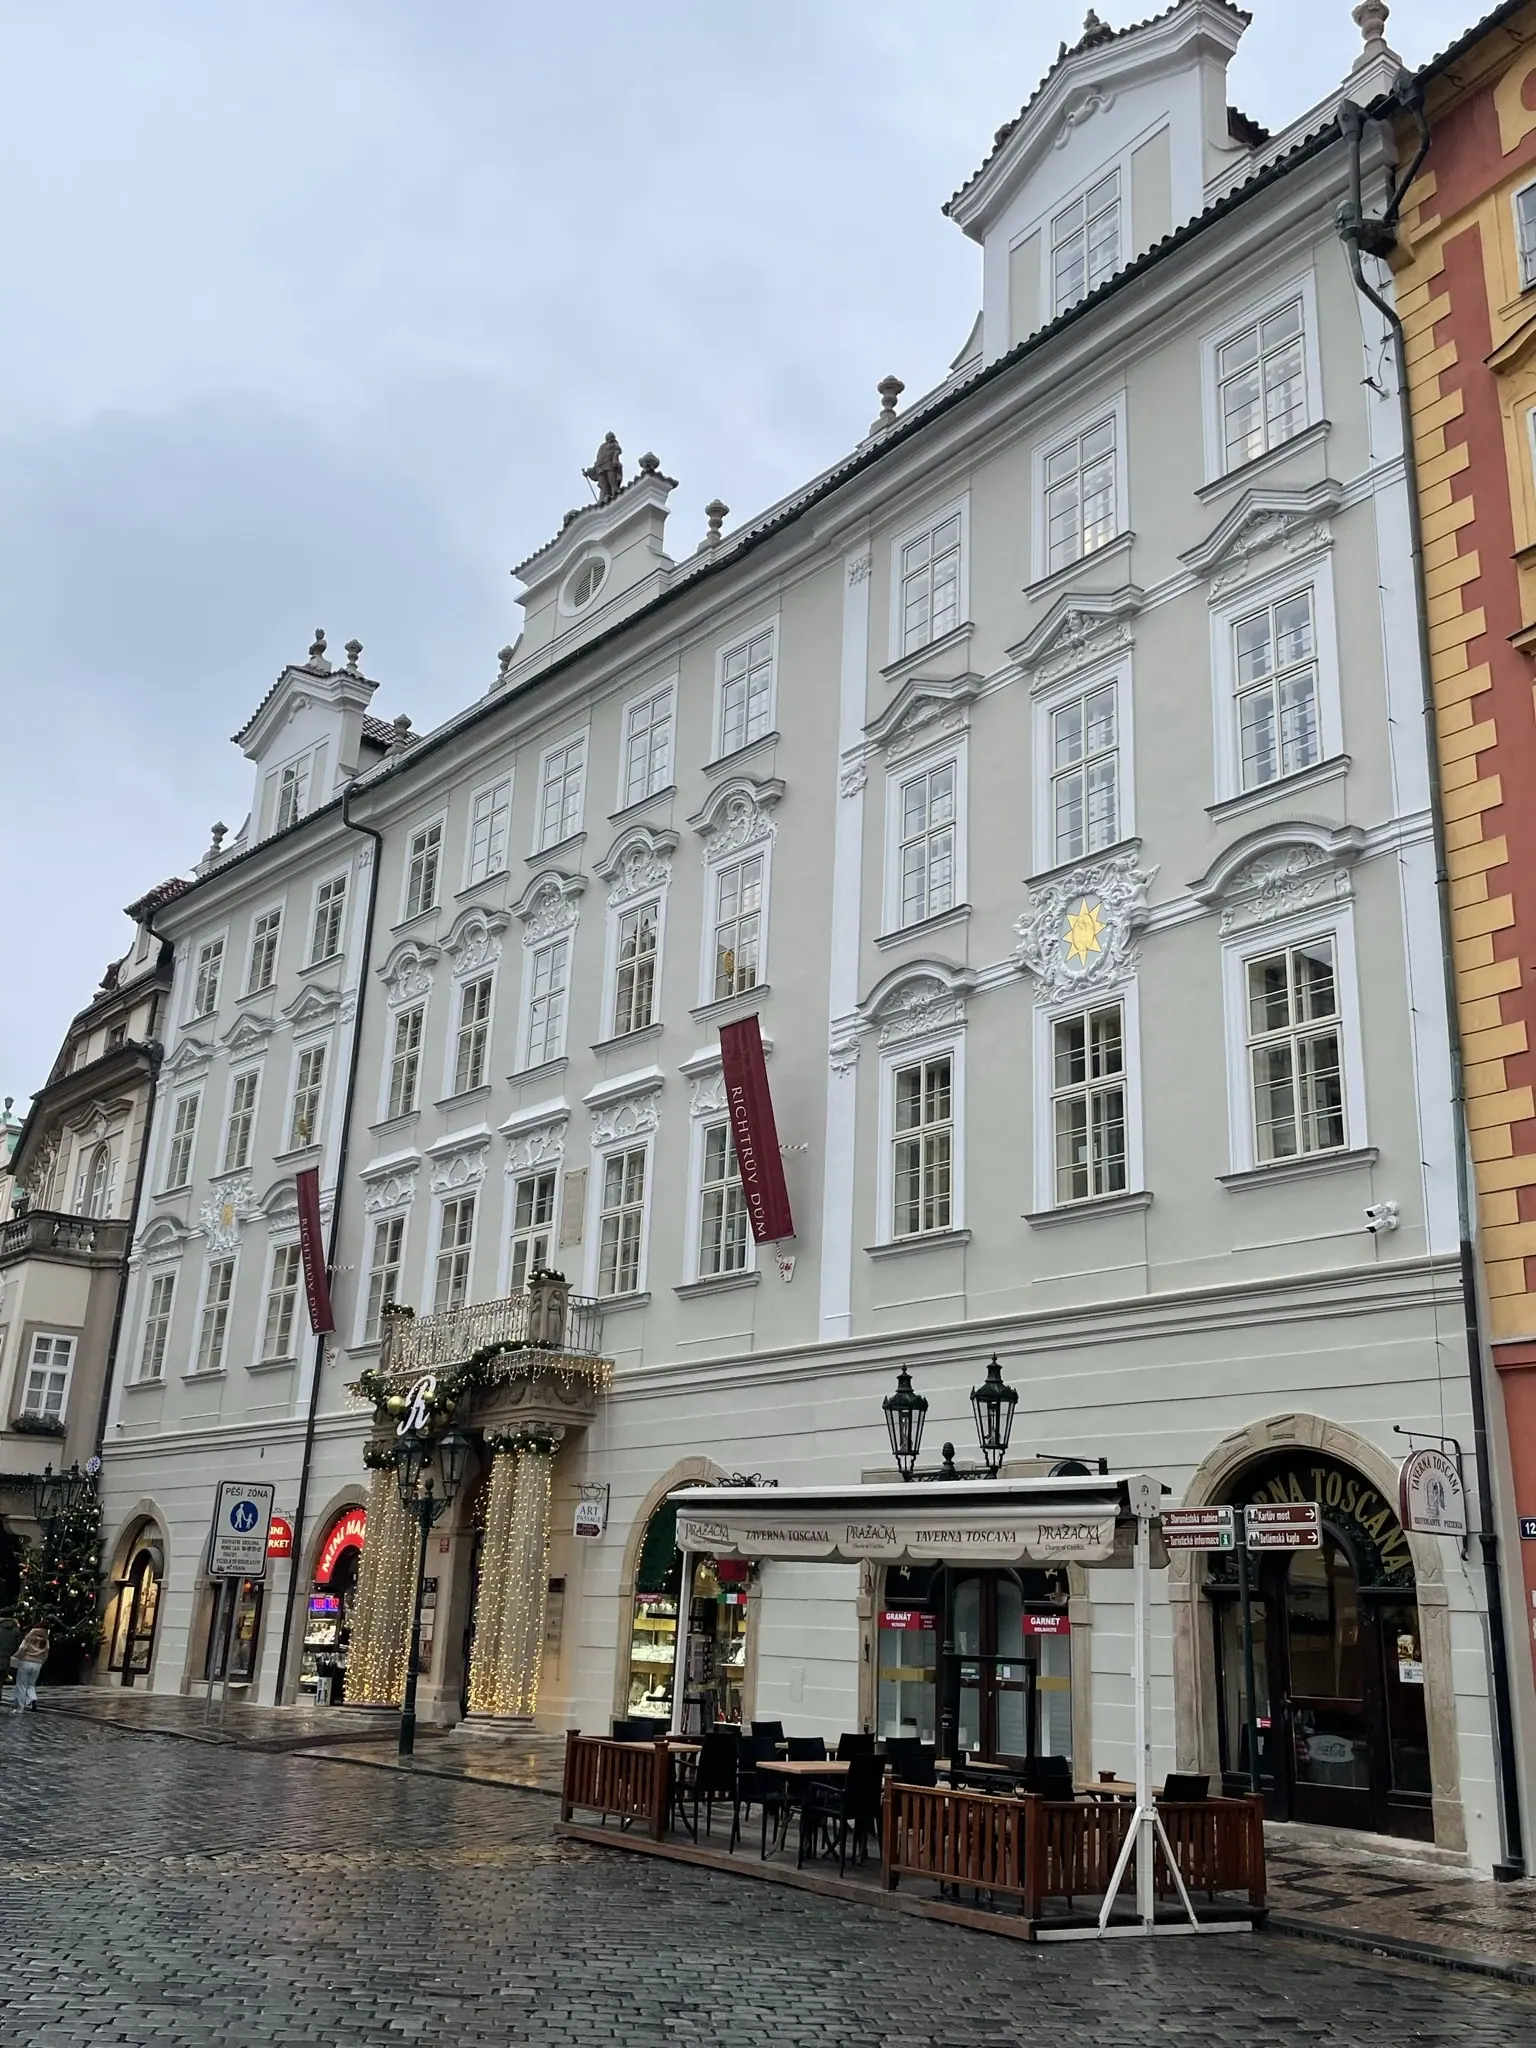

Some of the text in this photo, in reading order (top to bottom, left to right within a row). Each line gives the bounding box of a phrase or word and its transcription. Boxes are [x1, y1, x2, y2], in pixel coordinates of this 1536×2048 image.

[1412, 1456, 1460, 1496] TAVERNA TOSCANA
[247, 1488, 268, 1498] ZÓNA
[580, 1505, 599, 1516] ART
[1276, 1509, 1291, 1520] most
[576, 1514, 601, 1522] PASSAGE
[1201, 1512, 1219, 1523] radnice
[1310, 1468, 1413, 1574] TOSCANA
[269, 1526, 284, 1535] INI
[745, 1530, 830, 1542] TAVERNA TOSCANA
[915, 1530, 1016, 1543] TAVERNA TOSCANA
[268, 1539, 290, 1548] RKET
[321, 1527, 345, 1573] MINI
[885, 1612, 912, 1621] GRANÁT
